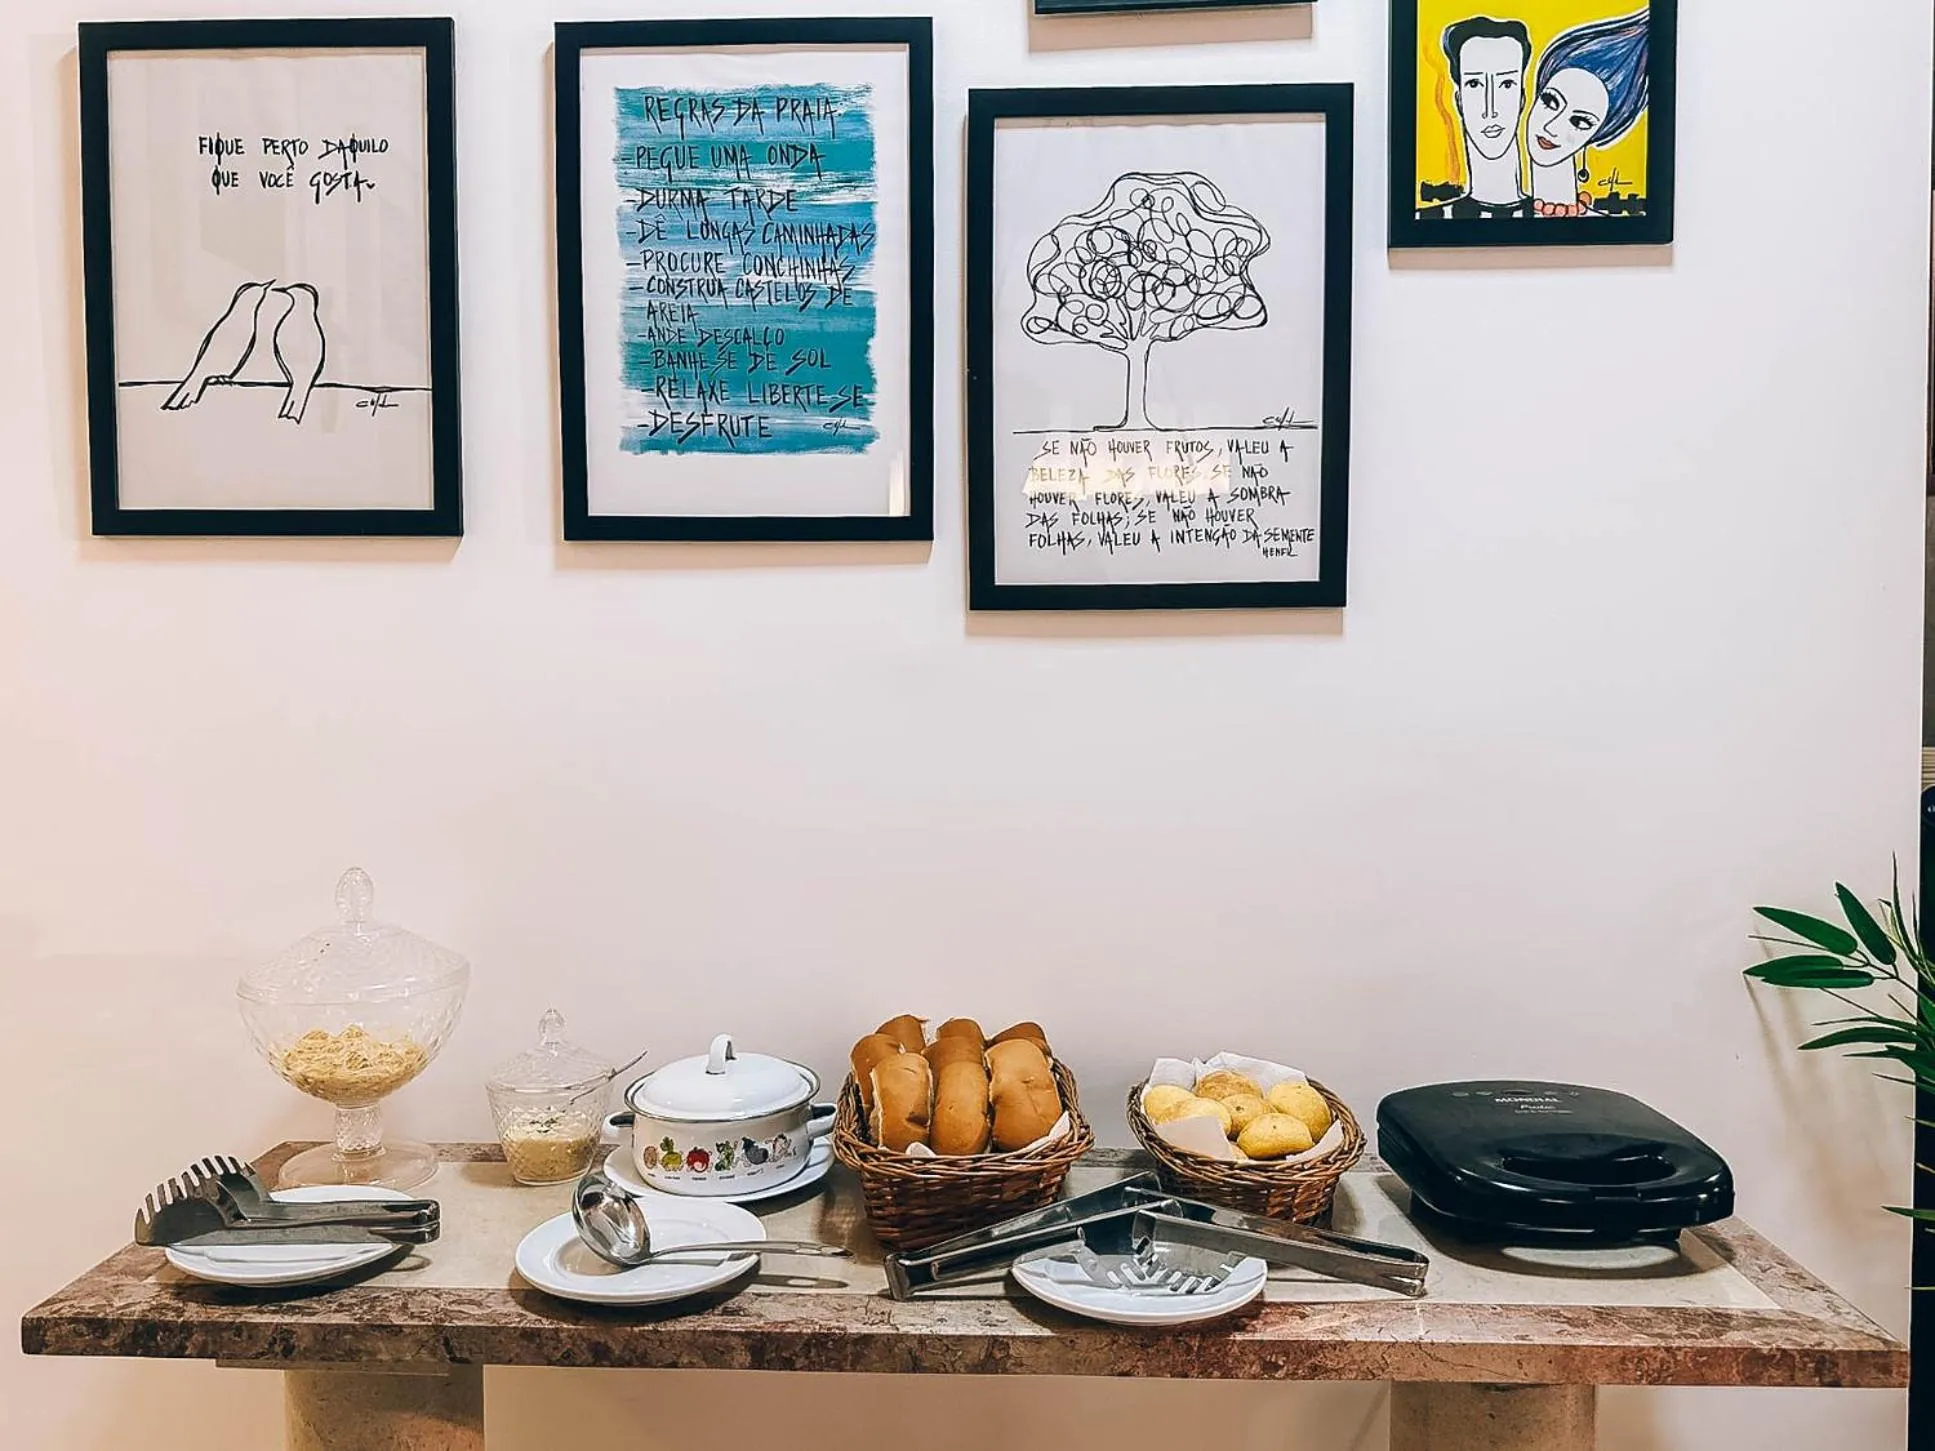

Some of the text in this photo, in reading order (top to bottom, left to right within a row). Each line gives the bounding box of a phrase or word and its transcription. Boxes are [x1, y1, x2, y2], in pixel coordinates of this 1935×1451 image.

[644, 96, 725, 140] REGRAS
[732, 97, 765, 135] DA
[199, 132, 388, 170] FIQUE PERTO DAQUILO
[711, 144, 752, 180] UMA
[767, 143, 826, 181] ONDA
[211, 165, 240, 195] QUE
[259, 165, 294, 188] VOCÊ
[724, 186, 798, 226] TARDE
[687, 220, 755, 254] LONGAS
[762, 222, 875, 262] CAMINHADAS
[743, 252, 855, 292] CONCHINHAS
[736, 278, 816, 312] CASTELOS
[825, 286, 852, 308] DE
[647, 300, 699, 334] AREIA
[748, 352, 777, 373] DE
[785, 348, 831, 376] SOL
[1033, 440, 1060, 460] SE
[1070, 438, 1097, 467] NÃO
[1108, 438, 1153, 461] HOUVER
[1227, 439, 1270, 464] VALEU
[1280, 440, 1294, 462] A
[1028, 465, 1090, 495] BELEZA
[1242, 463, 1268, 486] NÃO
[1029, 490, 1080, 513] HOUVER
[1156, 489, 1195, 511] VALEU
[1207, 488, 1220, 510] A
[1226, 486, 1291, 507] SOMBRA
[1025, 512, 1059, 533] DAS
[1134, 509, 1156, 526] SE
[1172, 505, 1196, 528] NÃO
[1206, 507, 1259, 530] HOUVER
[1098, 530, 1140, 555] VALEU
[1151, 529, 1161, 552] A
[1171, 524, 1237, 548] INTENÇÃO
[1242, 529, 1262, 549] DA
[1263, 528, 1315, 550] SEMENTE
